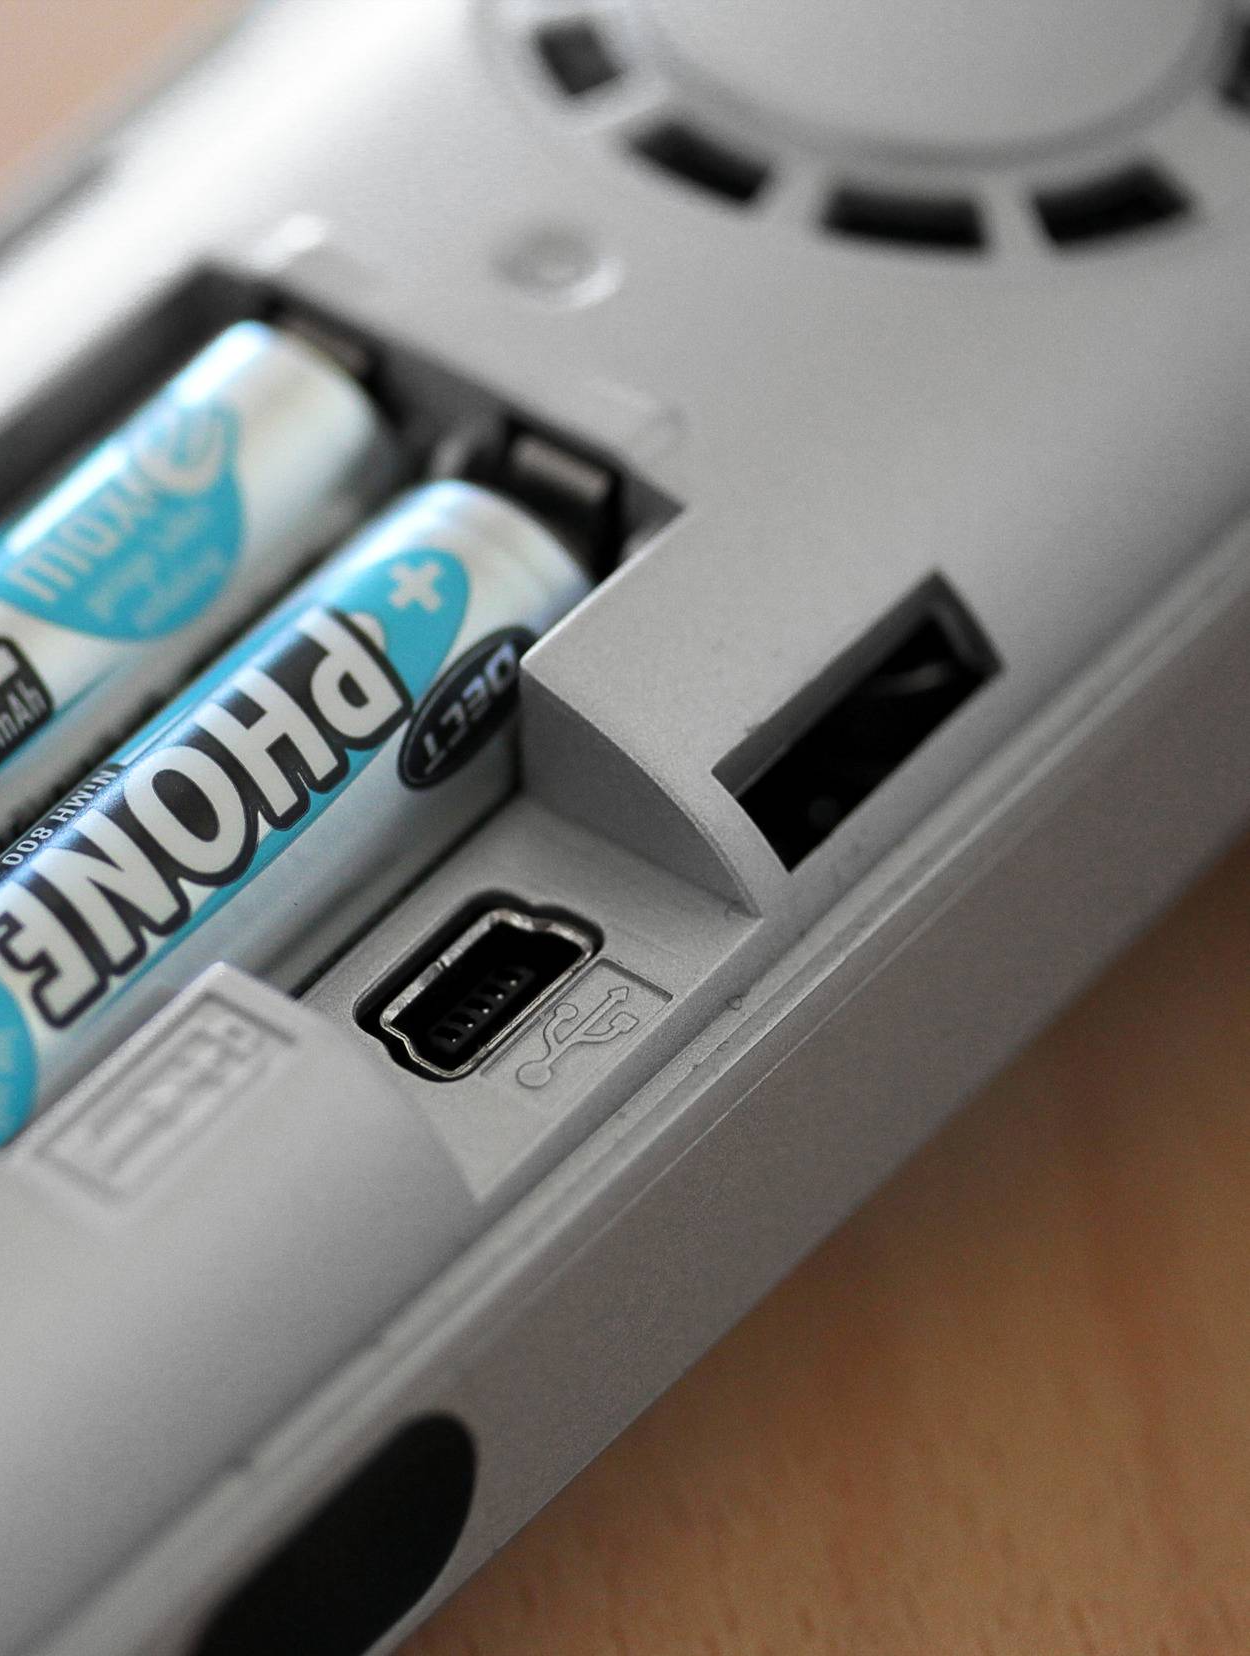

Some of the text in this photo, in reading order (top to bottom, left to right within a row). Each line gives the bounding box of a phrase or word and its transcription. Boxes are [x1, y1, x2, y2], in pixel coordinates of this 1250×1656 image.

[423, 641, 519, 775] DECT
[50, 770, 117, 822] NiMH
[2, 827, 53, 866] 800
